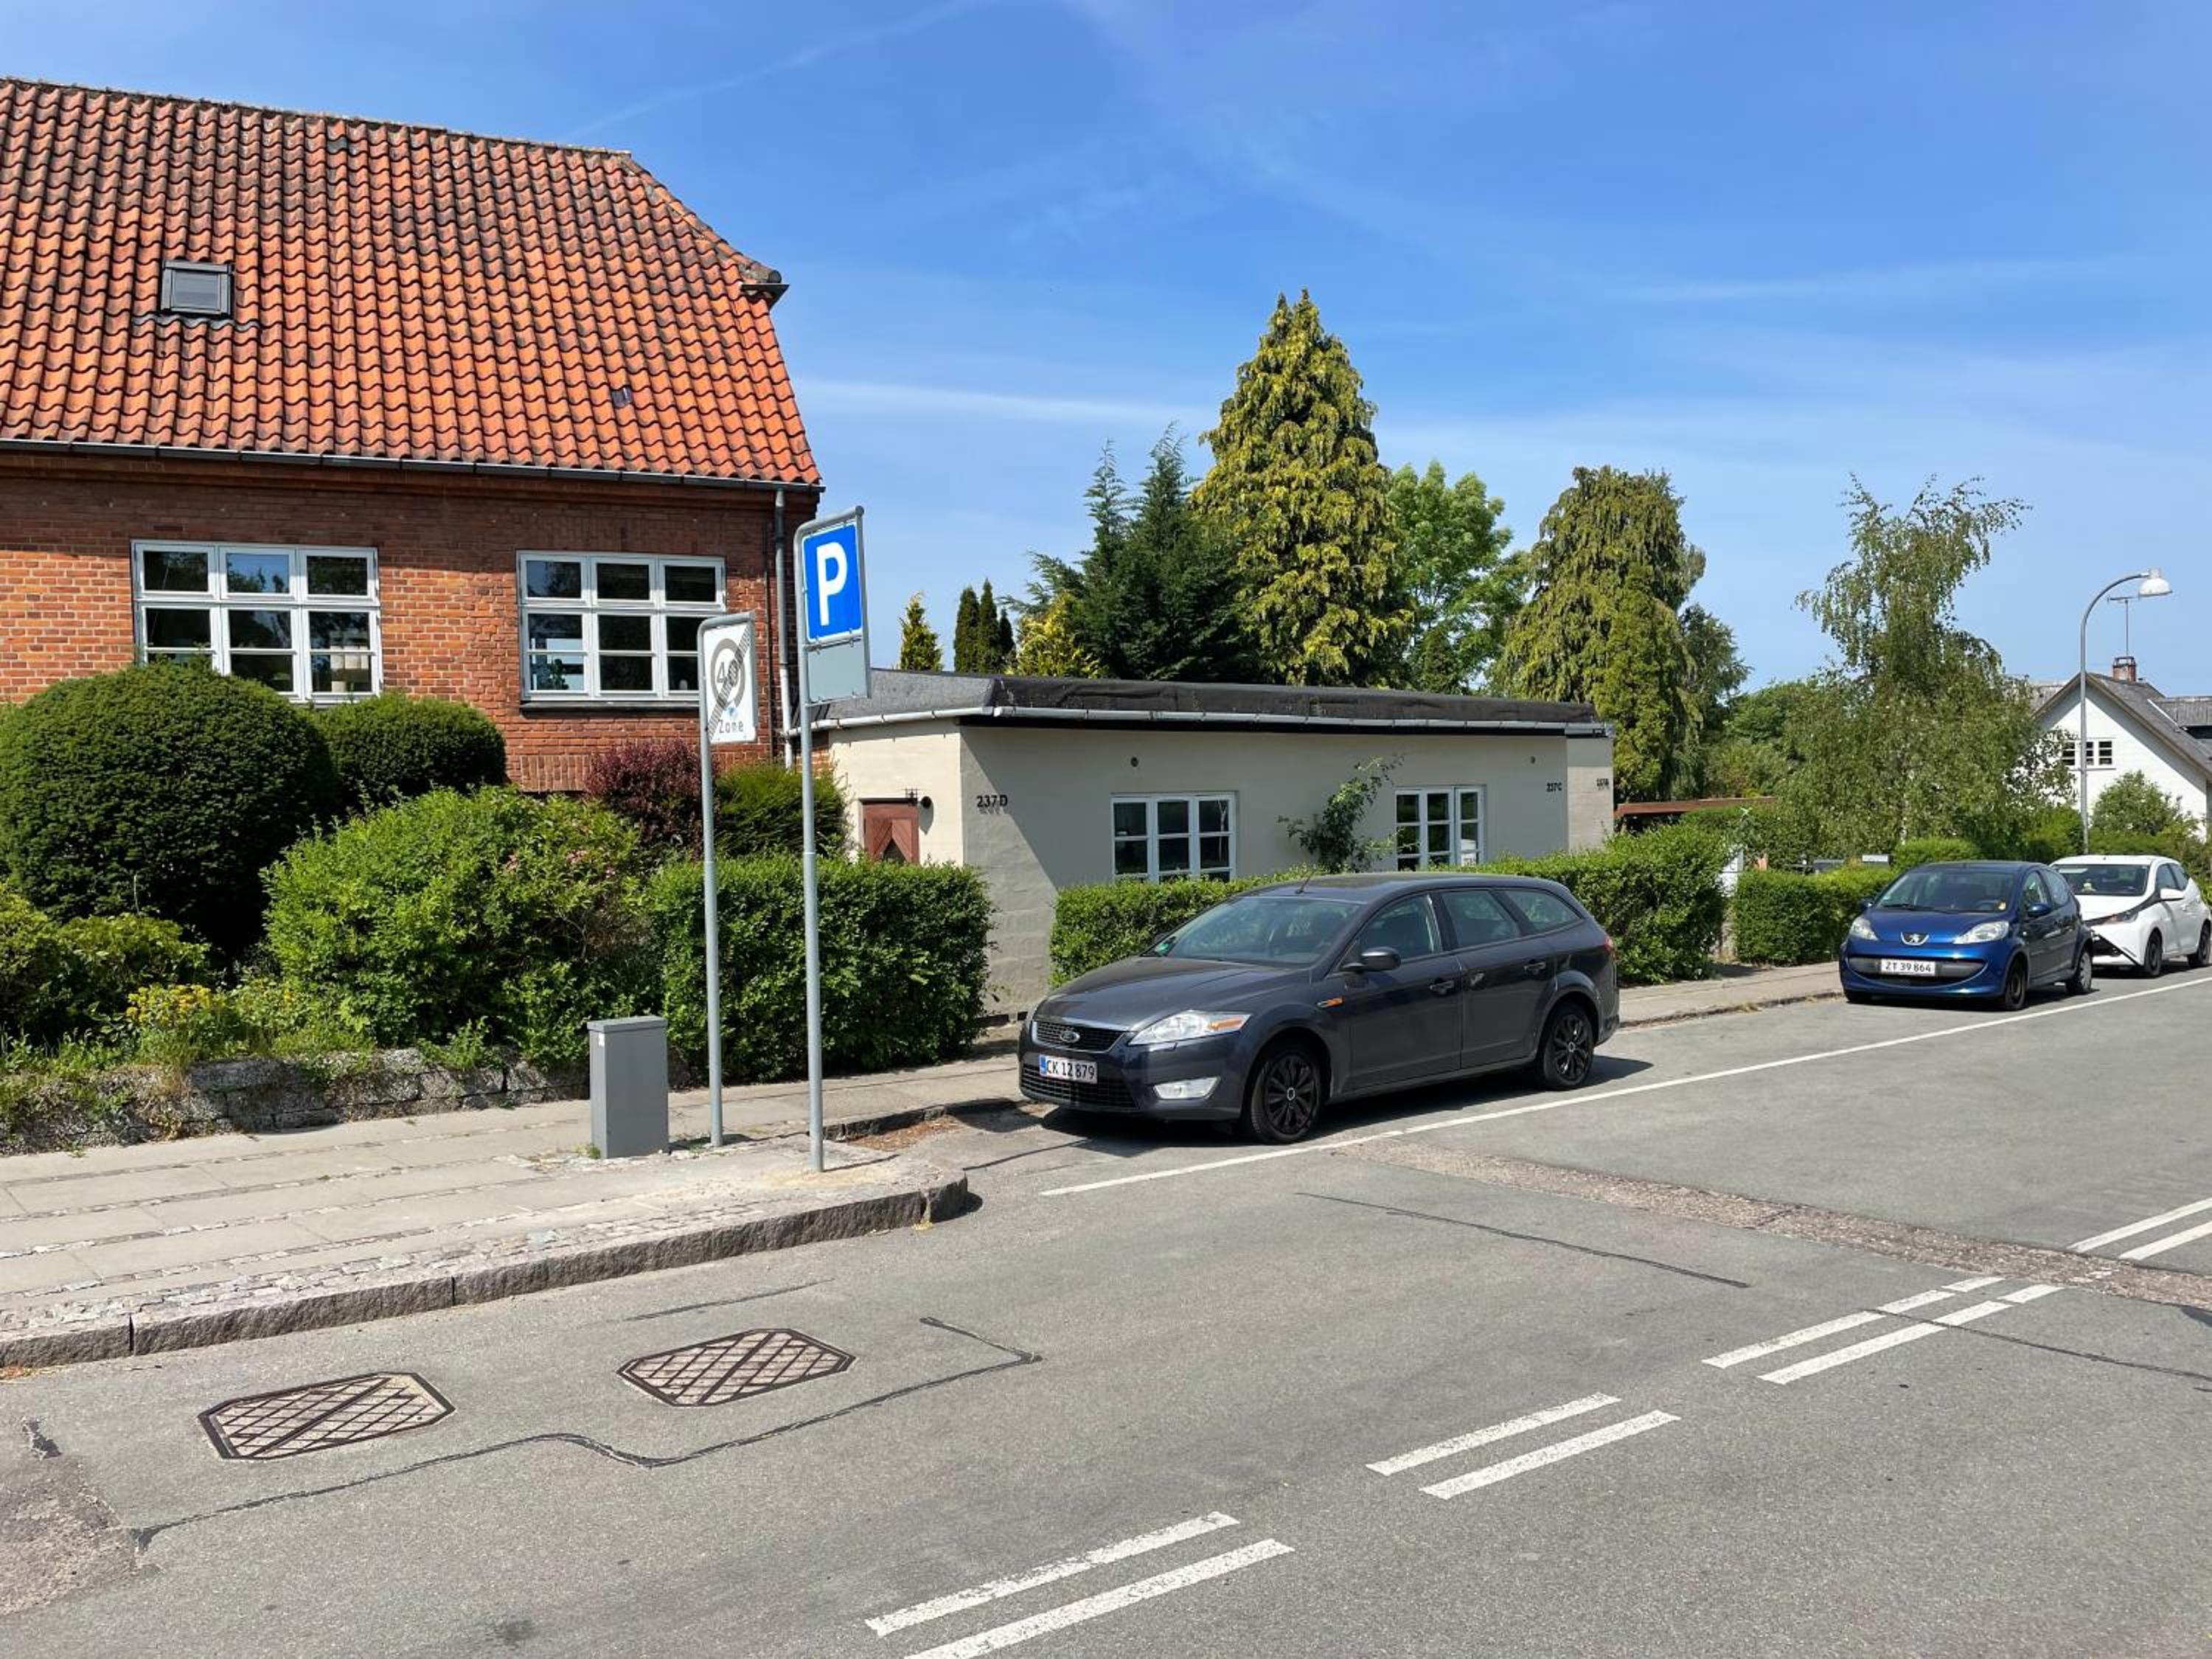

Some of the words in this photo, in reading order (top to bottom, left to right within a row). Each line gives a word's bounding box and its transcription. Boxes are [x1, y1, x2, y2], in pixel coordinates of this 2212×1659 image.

[816, 542, 847, 626] P
[719, 720, 744, 734] Zone
[1900, 962, 1912, 971] 39
[1913, 964, 1931, 973] 864
[1046, 1060, 1058, 1074] CK
[1062, 1062, 1073, 1077] 12
[1075, 1064, 1095, 1079] 879
